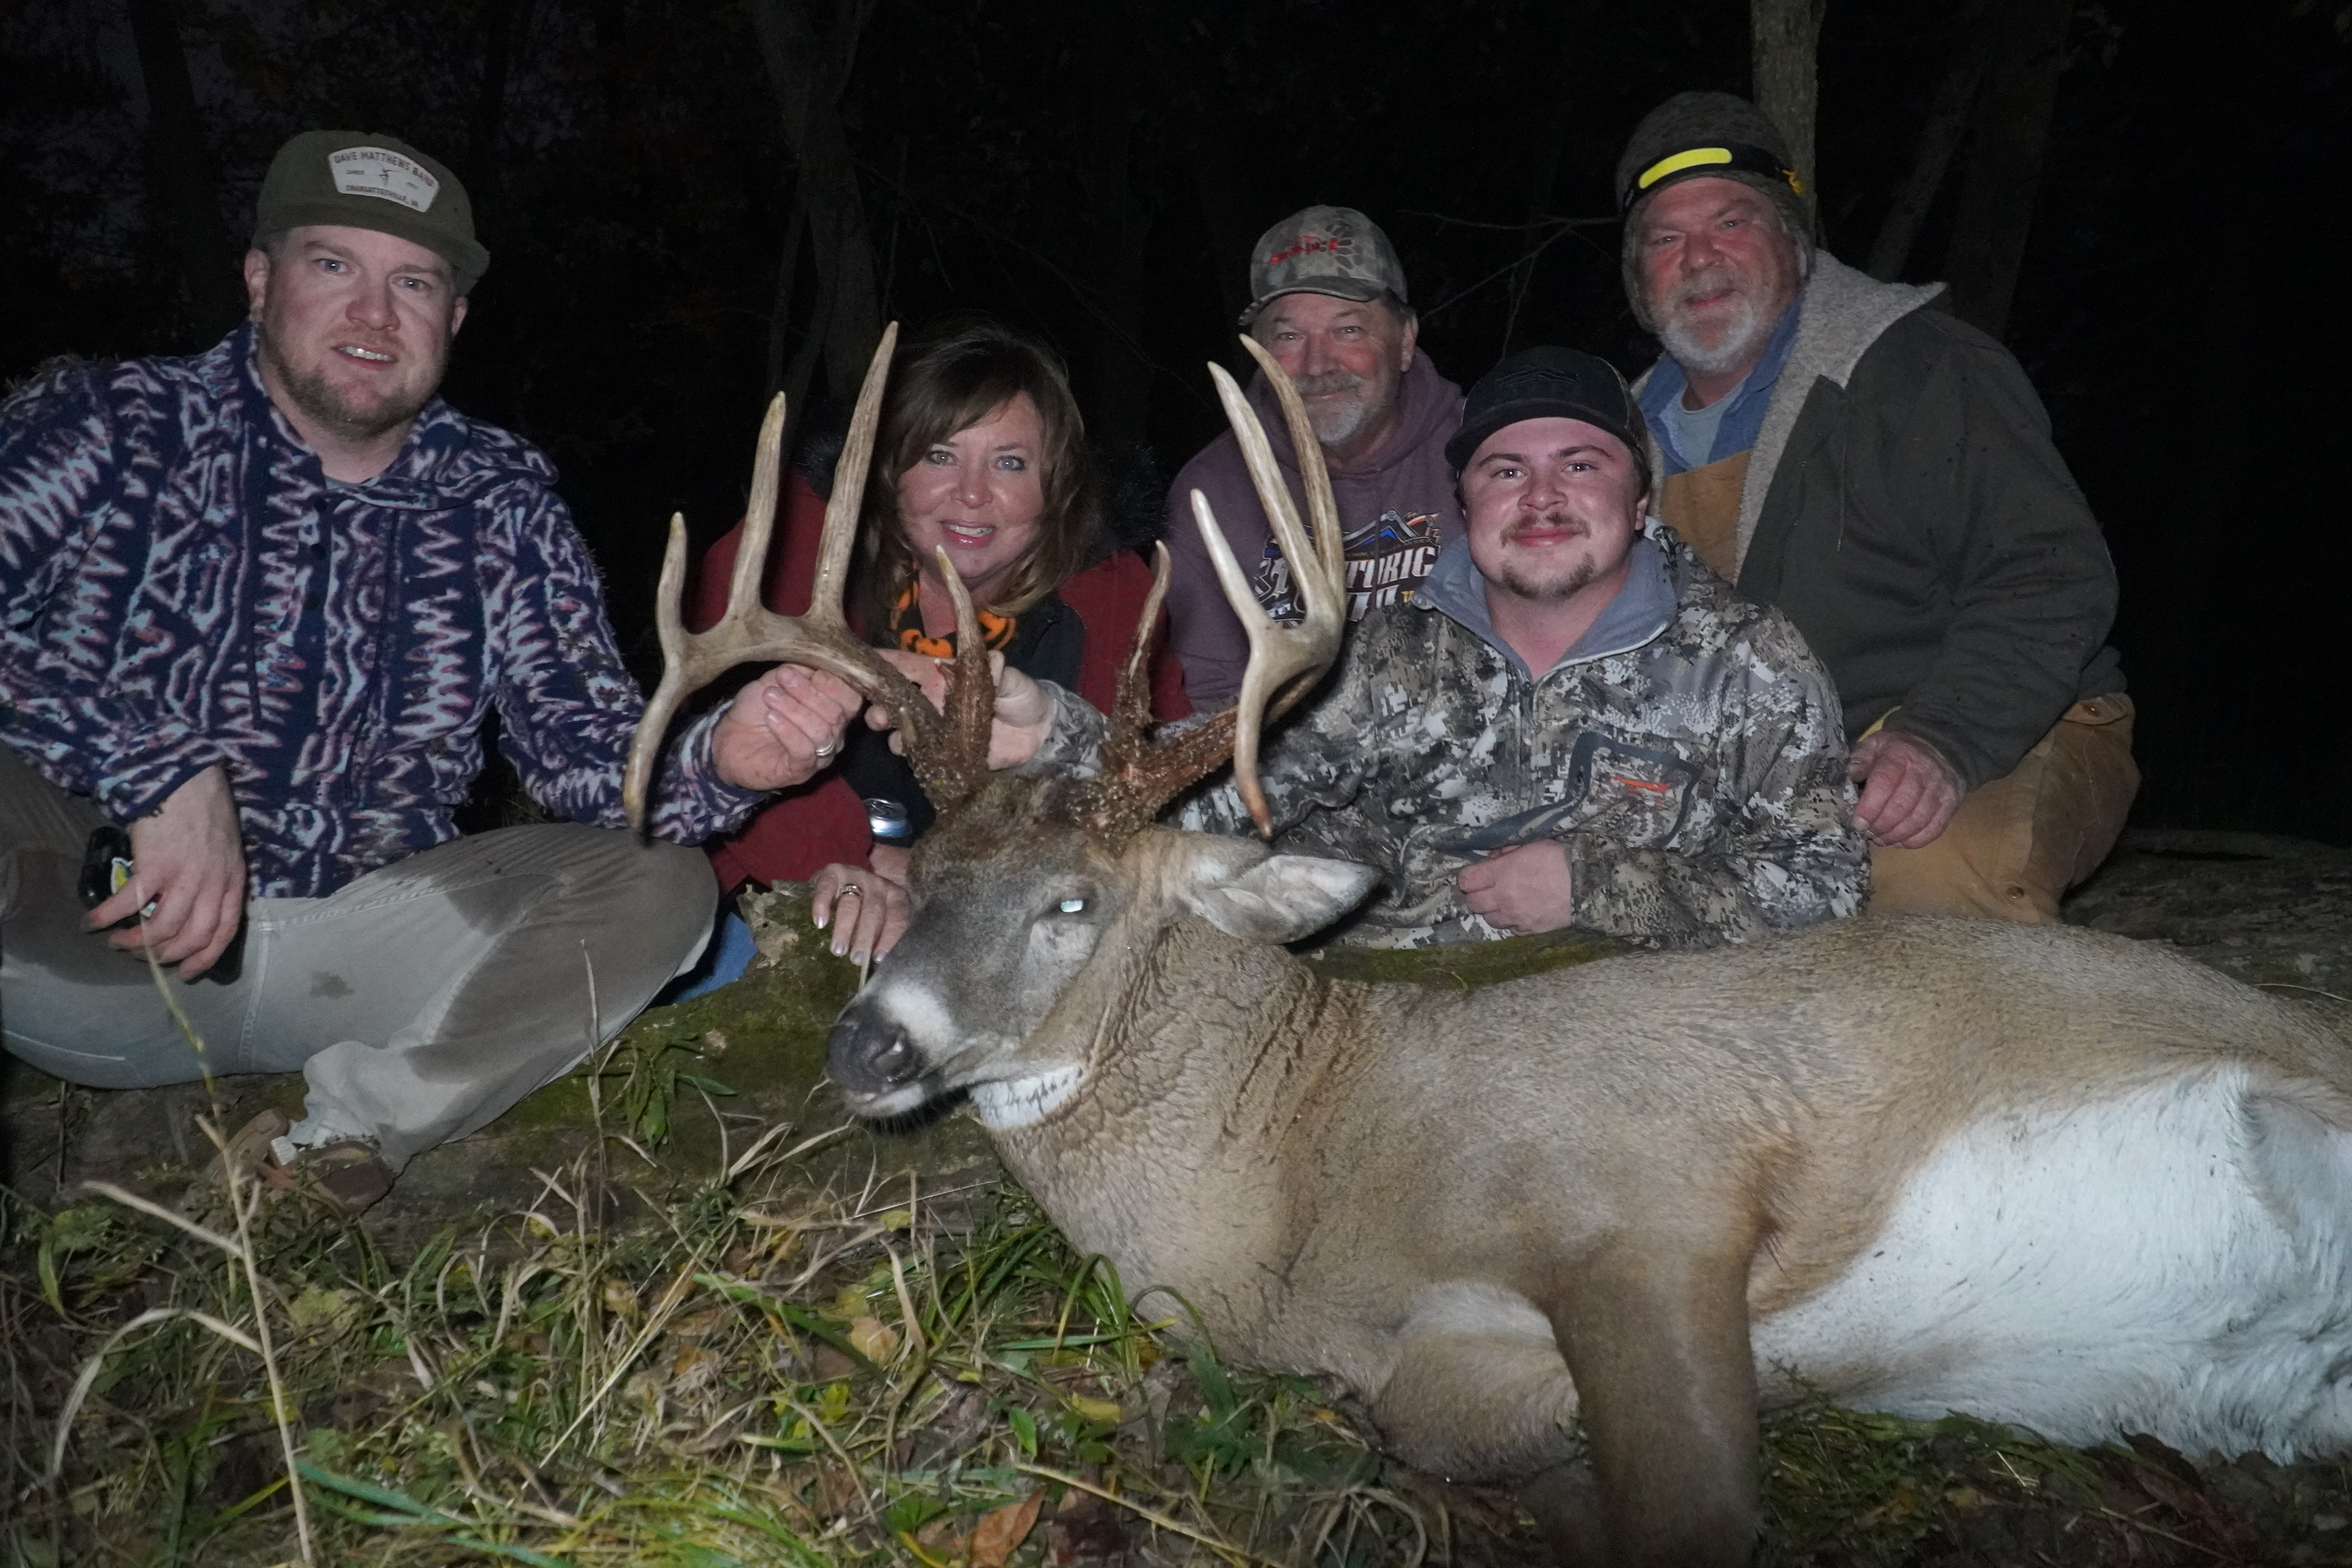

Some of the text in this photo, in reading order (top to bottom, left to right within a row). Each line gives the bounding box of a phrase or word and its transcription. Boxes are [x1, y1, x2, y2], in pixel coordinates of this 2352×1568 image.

[334, 151, 435, 187] DAVE MATTHEWS BAND
